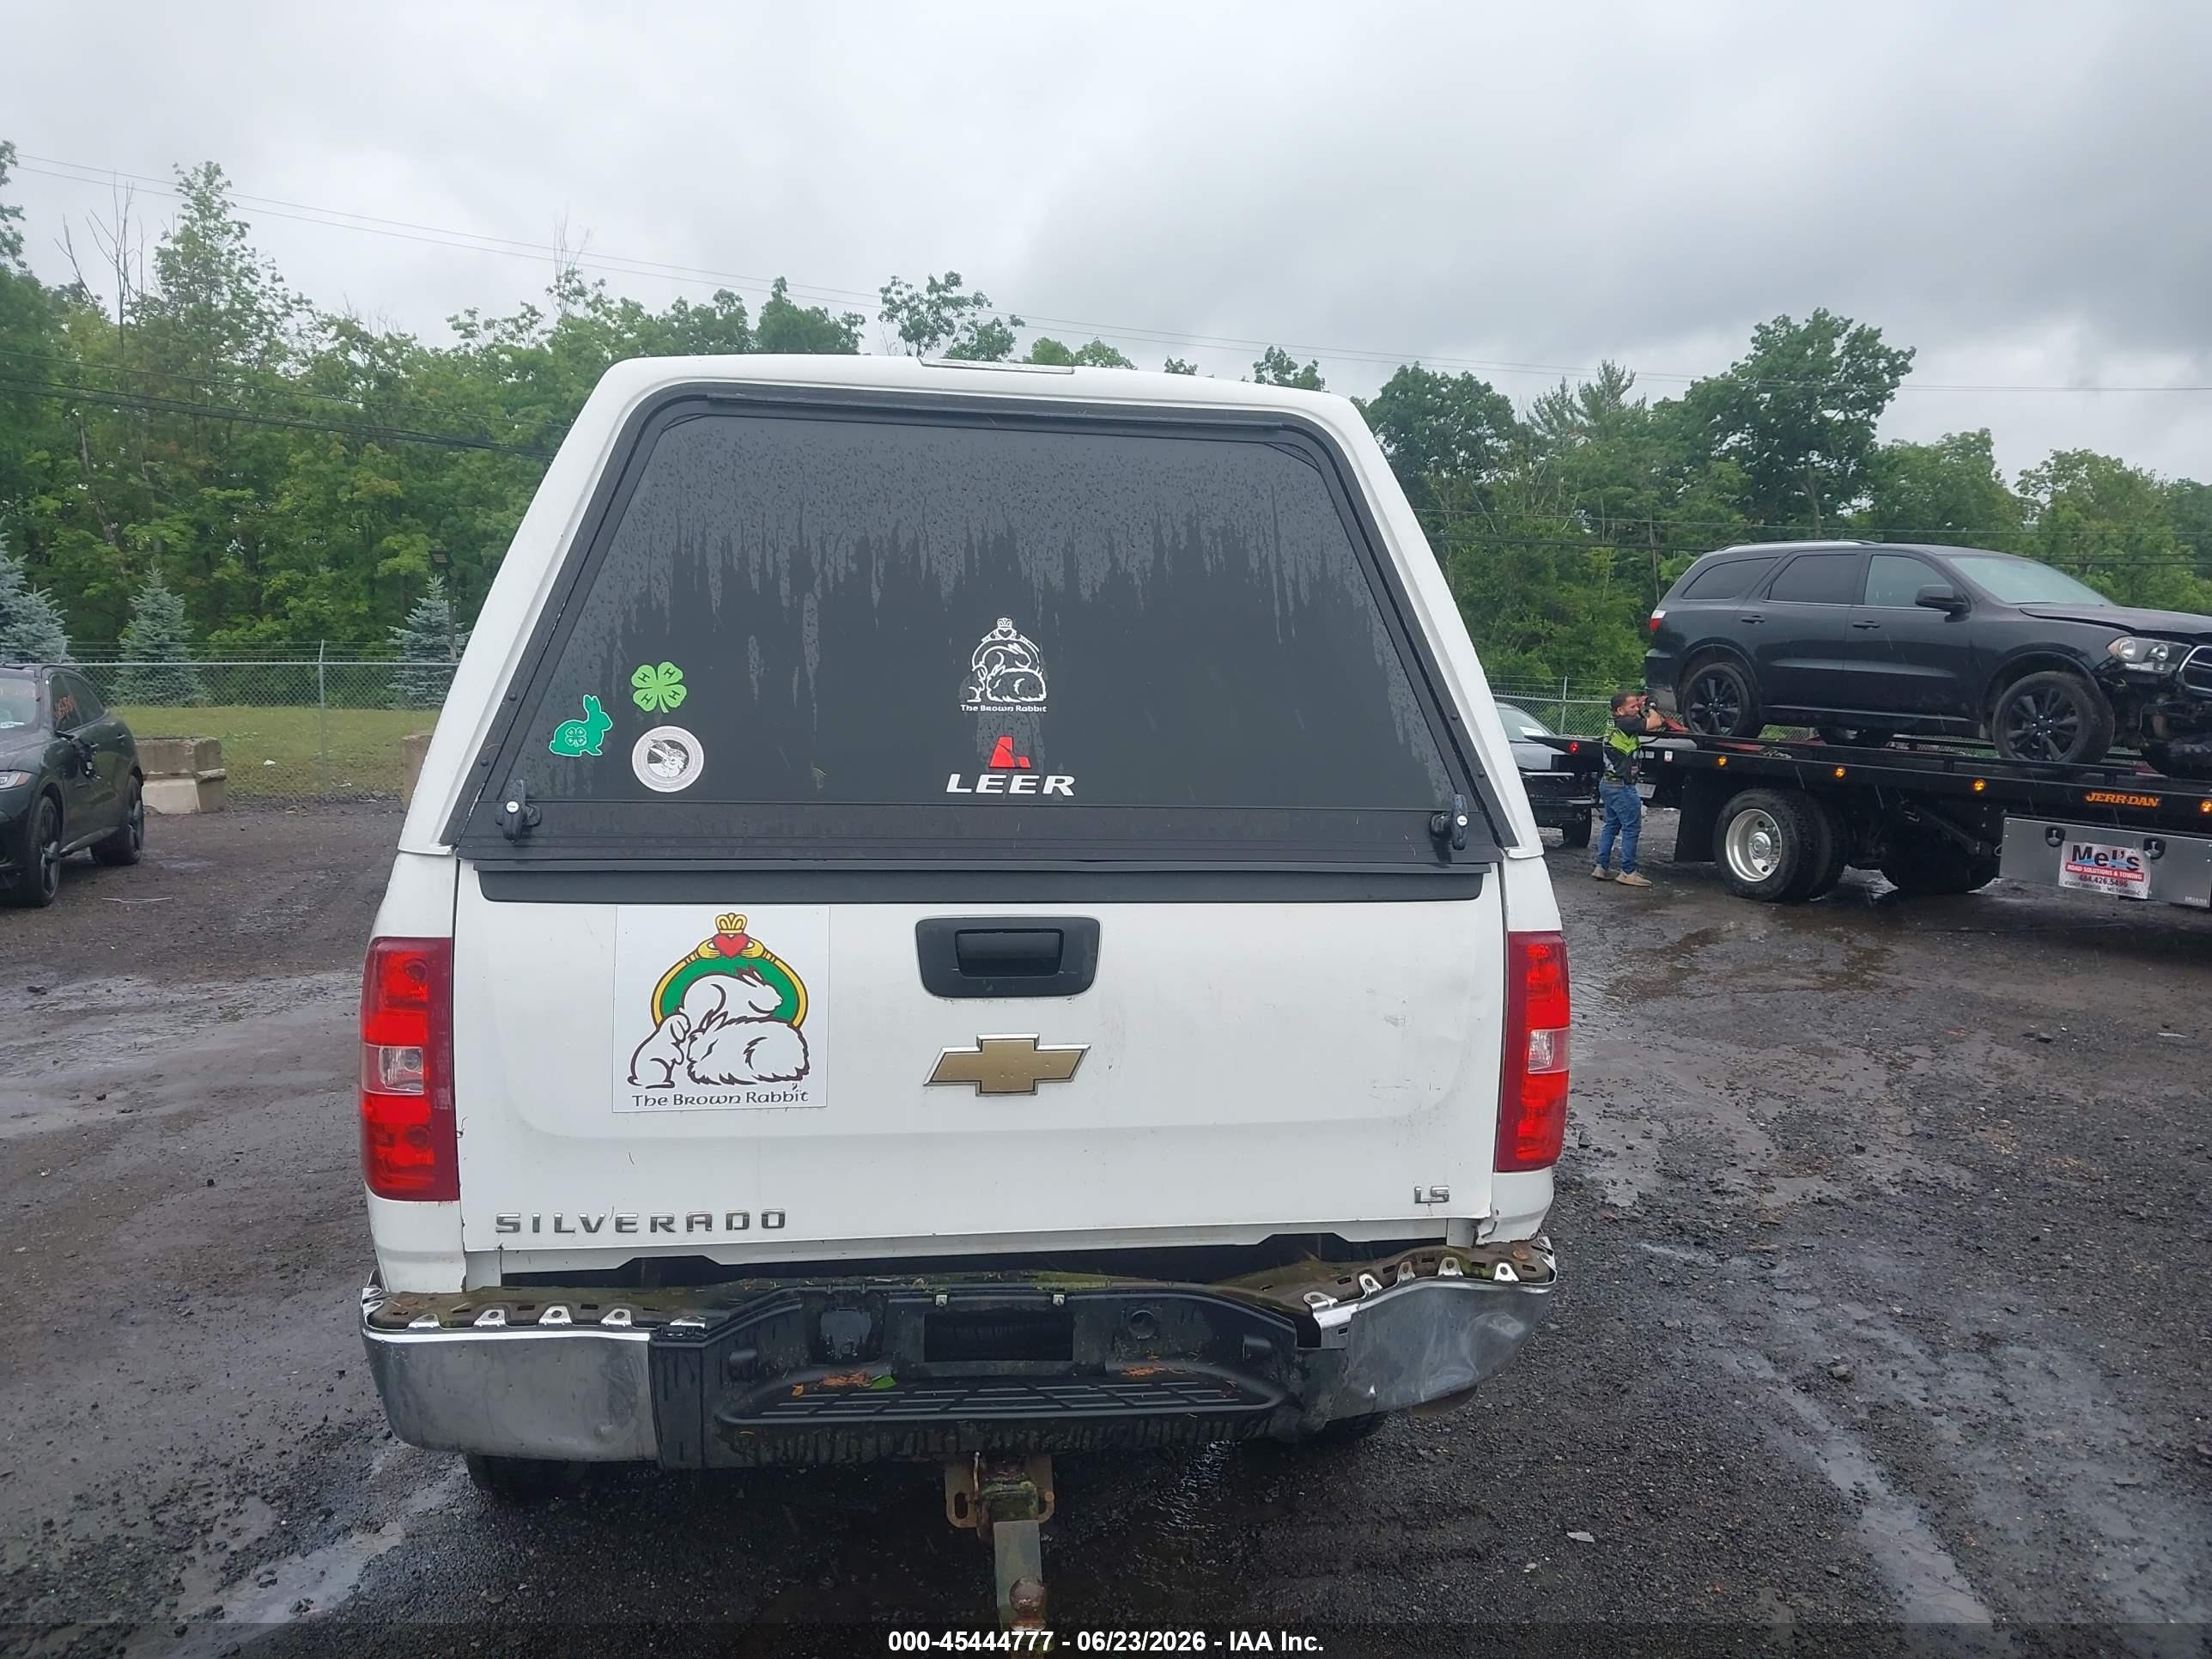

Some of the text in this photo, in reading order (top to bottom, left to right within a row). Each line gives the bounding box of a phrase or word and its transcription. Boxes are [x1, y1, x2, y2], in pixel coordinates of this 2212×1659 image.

[1015, 704, 1048, 713] Rabbit
[945, 773, 1075, 796] LEER
[2071, 844, 2140, 872] Mel's
[2067, 864, 2082, 872] ROAD
[2082, 866, 2112, 876] SOLUTIONS
[2119, 871, 2142, 880] TOWING
[631, 1090, 810, 1107] The Brown Rabbit
[1413, 1185, 1449, 1204] LS
[495, 1208, 787, 1234] SILVERADO
